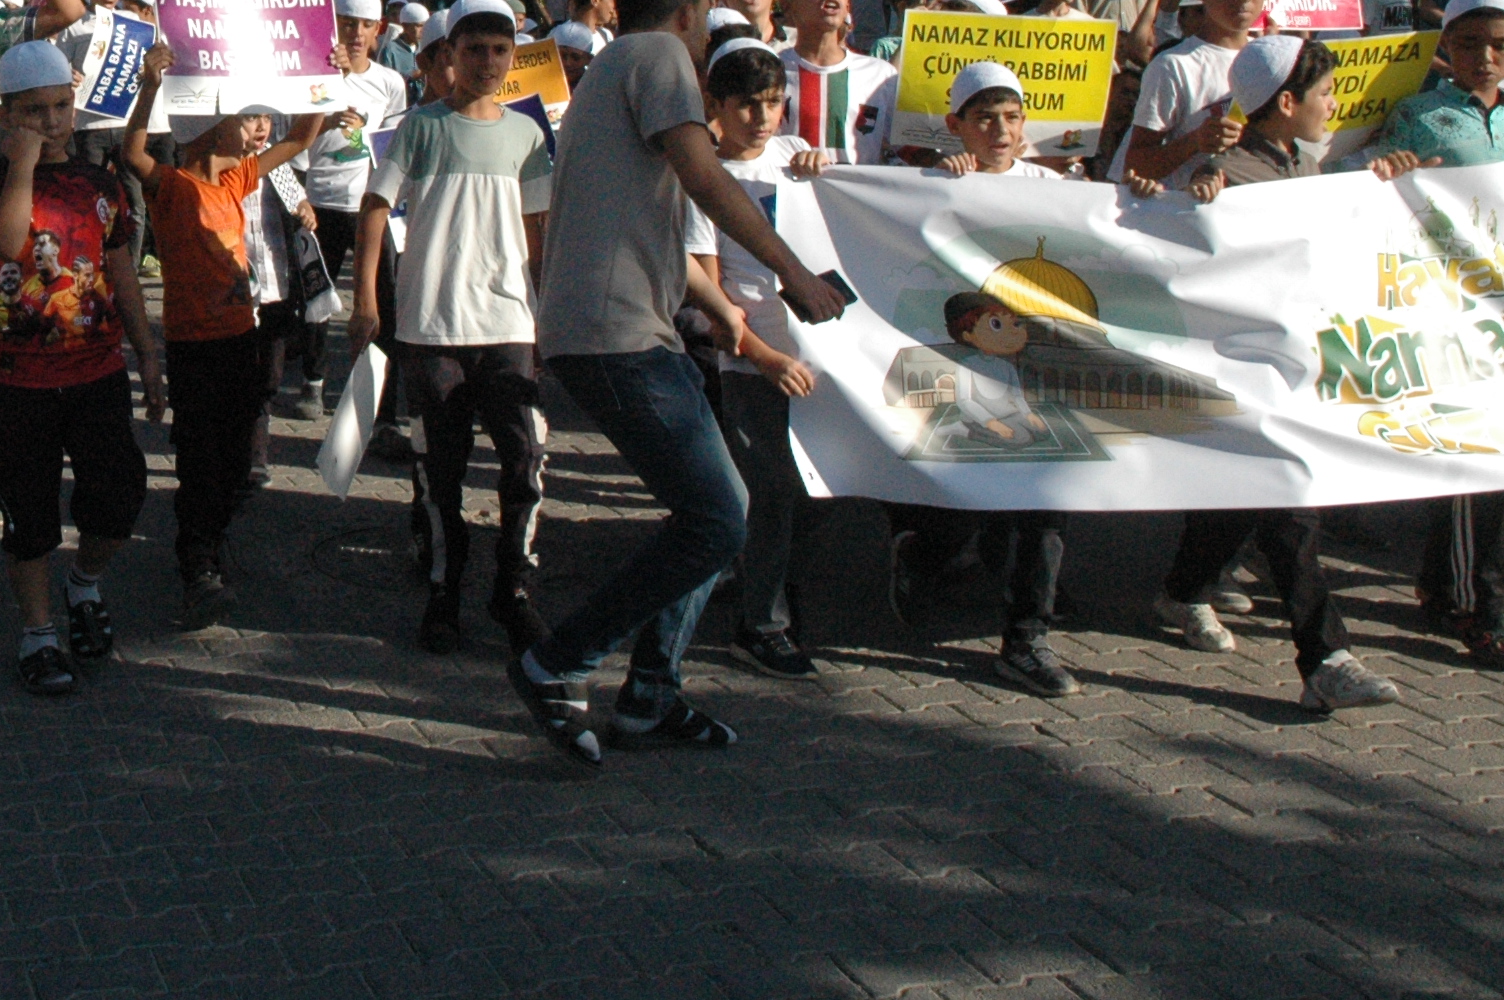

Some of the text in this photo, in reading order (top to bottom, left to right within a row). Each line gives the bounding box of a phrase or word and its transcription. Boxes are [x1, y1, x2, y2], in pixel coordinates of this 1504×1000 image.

[911, 24, 1105, 52] NAMAZ KILIYORUM
[91, 23, 127, 105] BABA BANA
[111, 38, 139, 97] NAMAZI
[1332, 70, 1368, 95] YDİ
